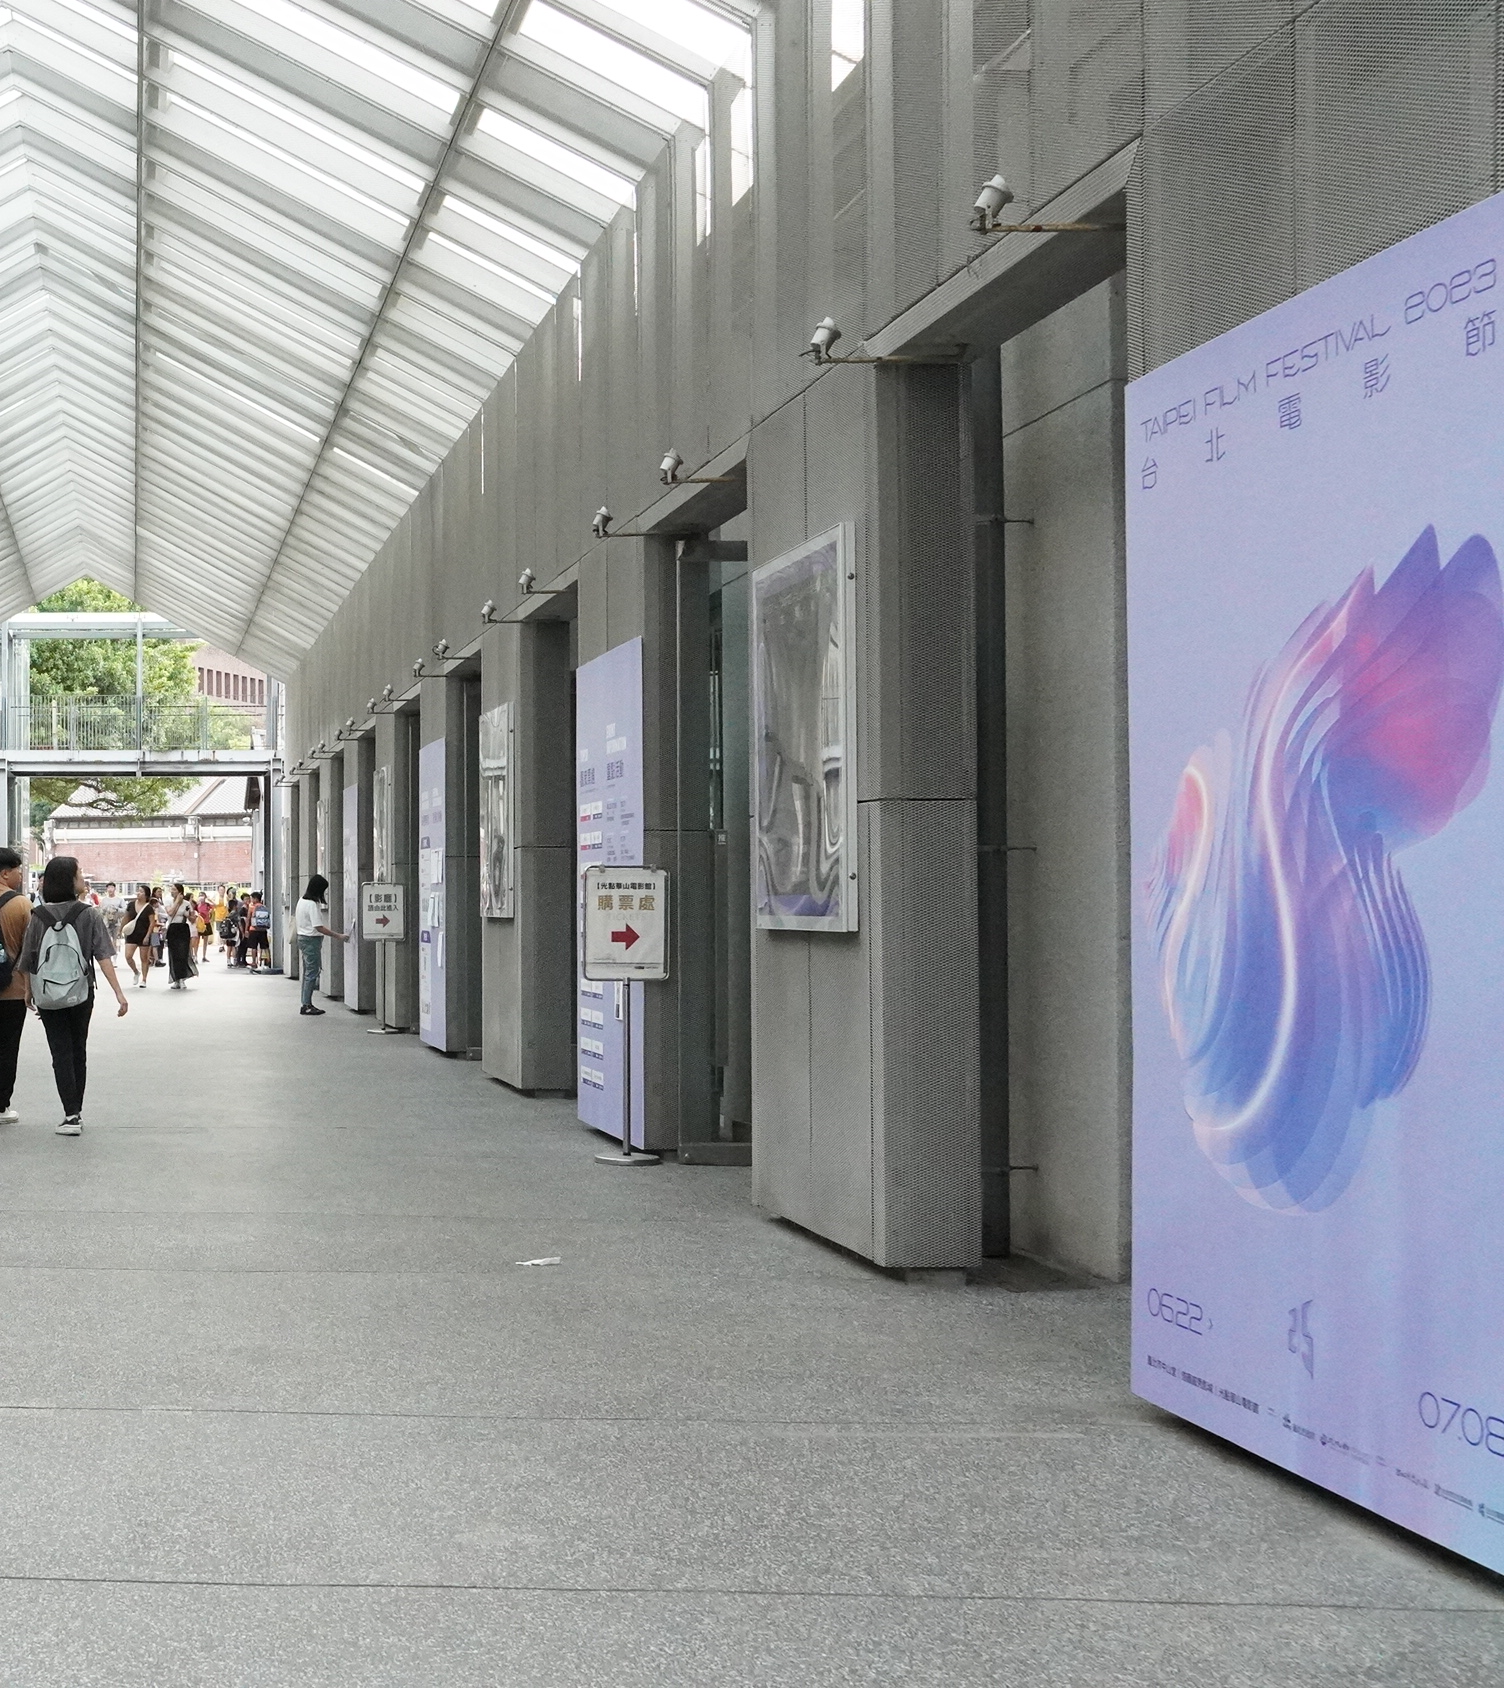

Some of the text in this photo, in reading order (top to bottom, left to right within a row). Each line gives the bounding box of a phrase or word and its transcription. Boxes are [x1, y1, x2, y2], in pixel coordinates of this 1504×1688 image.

[1139, 397, 1196, 443] TAIPEI
[1203, 370, 1257, 416] FILM
[1265, 313, 1392, 387] FESTIVAL
[597, 894, 655, 911] 購票處
[1147, 1287, 1203, 1336] 0622
[1418, 1391, 1504, 1457] 0708
